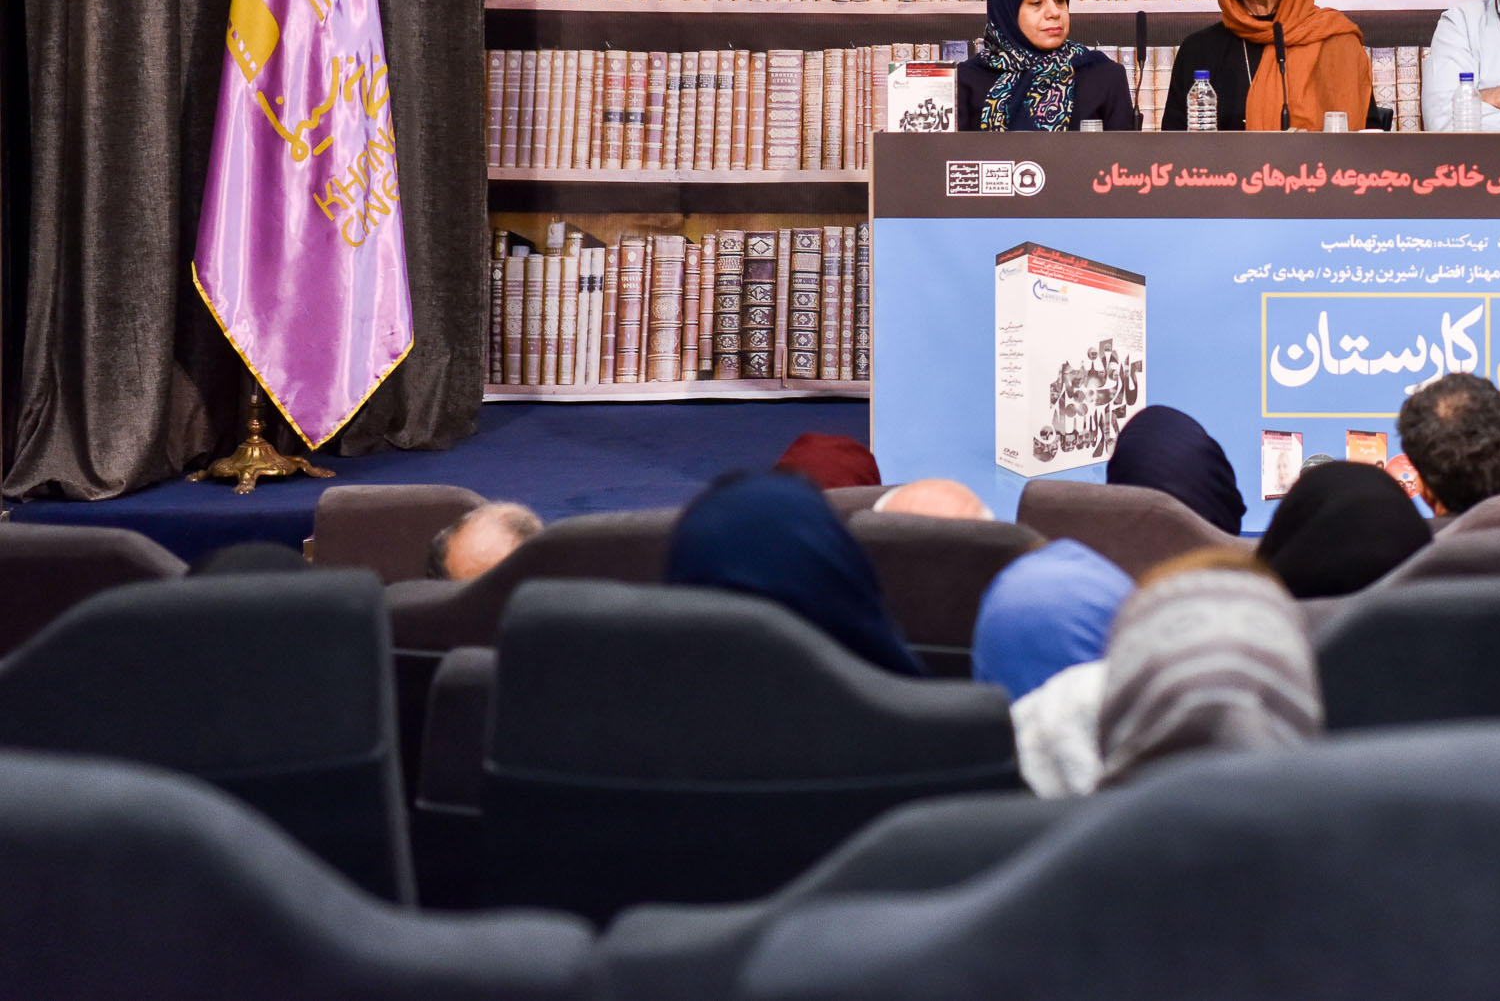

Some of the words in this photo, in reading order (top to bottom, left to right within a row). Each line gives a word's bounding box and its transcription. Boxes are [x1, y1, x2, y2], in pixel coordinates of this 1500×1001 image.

[1092, 162, 1174, 195] کارستان
[1174, 165, 1238, 187] مستند
[1330, 167, 1411, 195] مجموعه
[1412, 164, 1484, 195] خانگی
[1320, 234, 1394, 253] میرتهماسب
[1395, 234, 1433, 250] مجتبا
[1233, 263, 1271, 284] گنجی
[1271, 266, 1315, 284] مهدی
[1376, 265, 1419, 284] شیرین
[1424, 265, 1466, 284] افضلی
[1468, 266, 1500, 283] مهناز
[1269, 303, 1485, 396] کارستان
